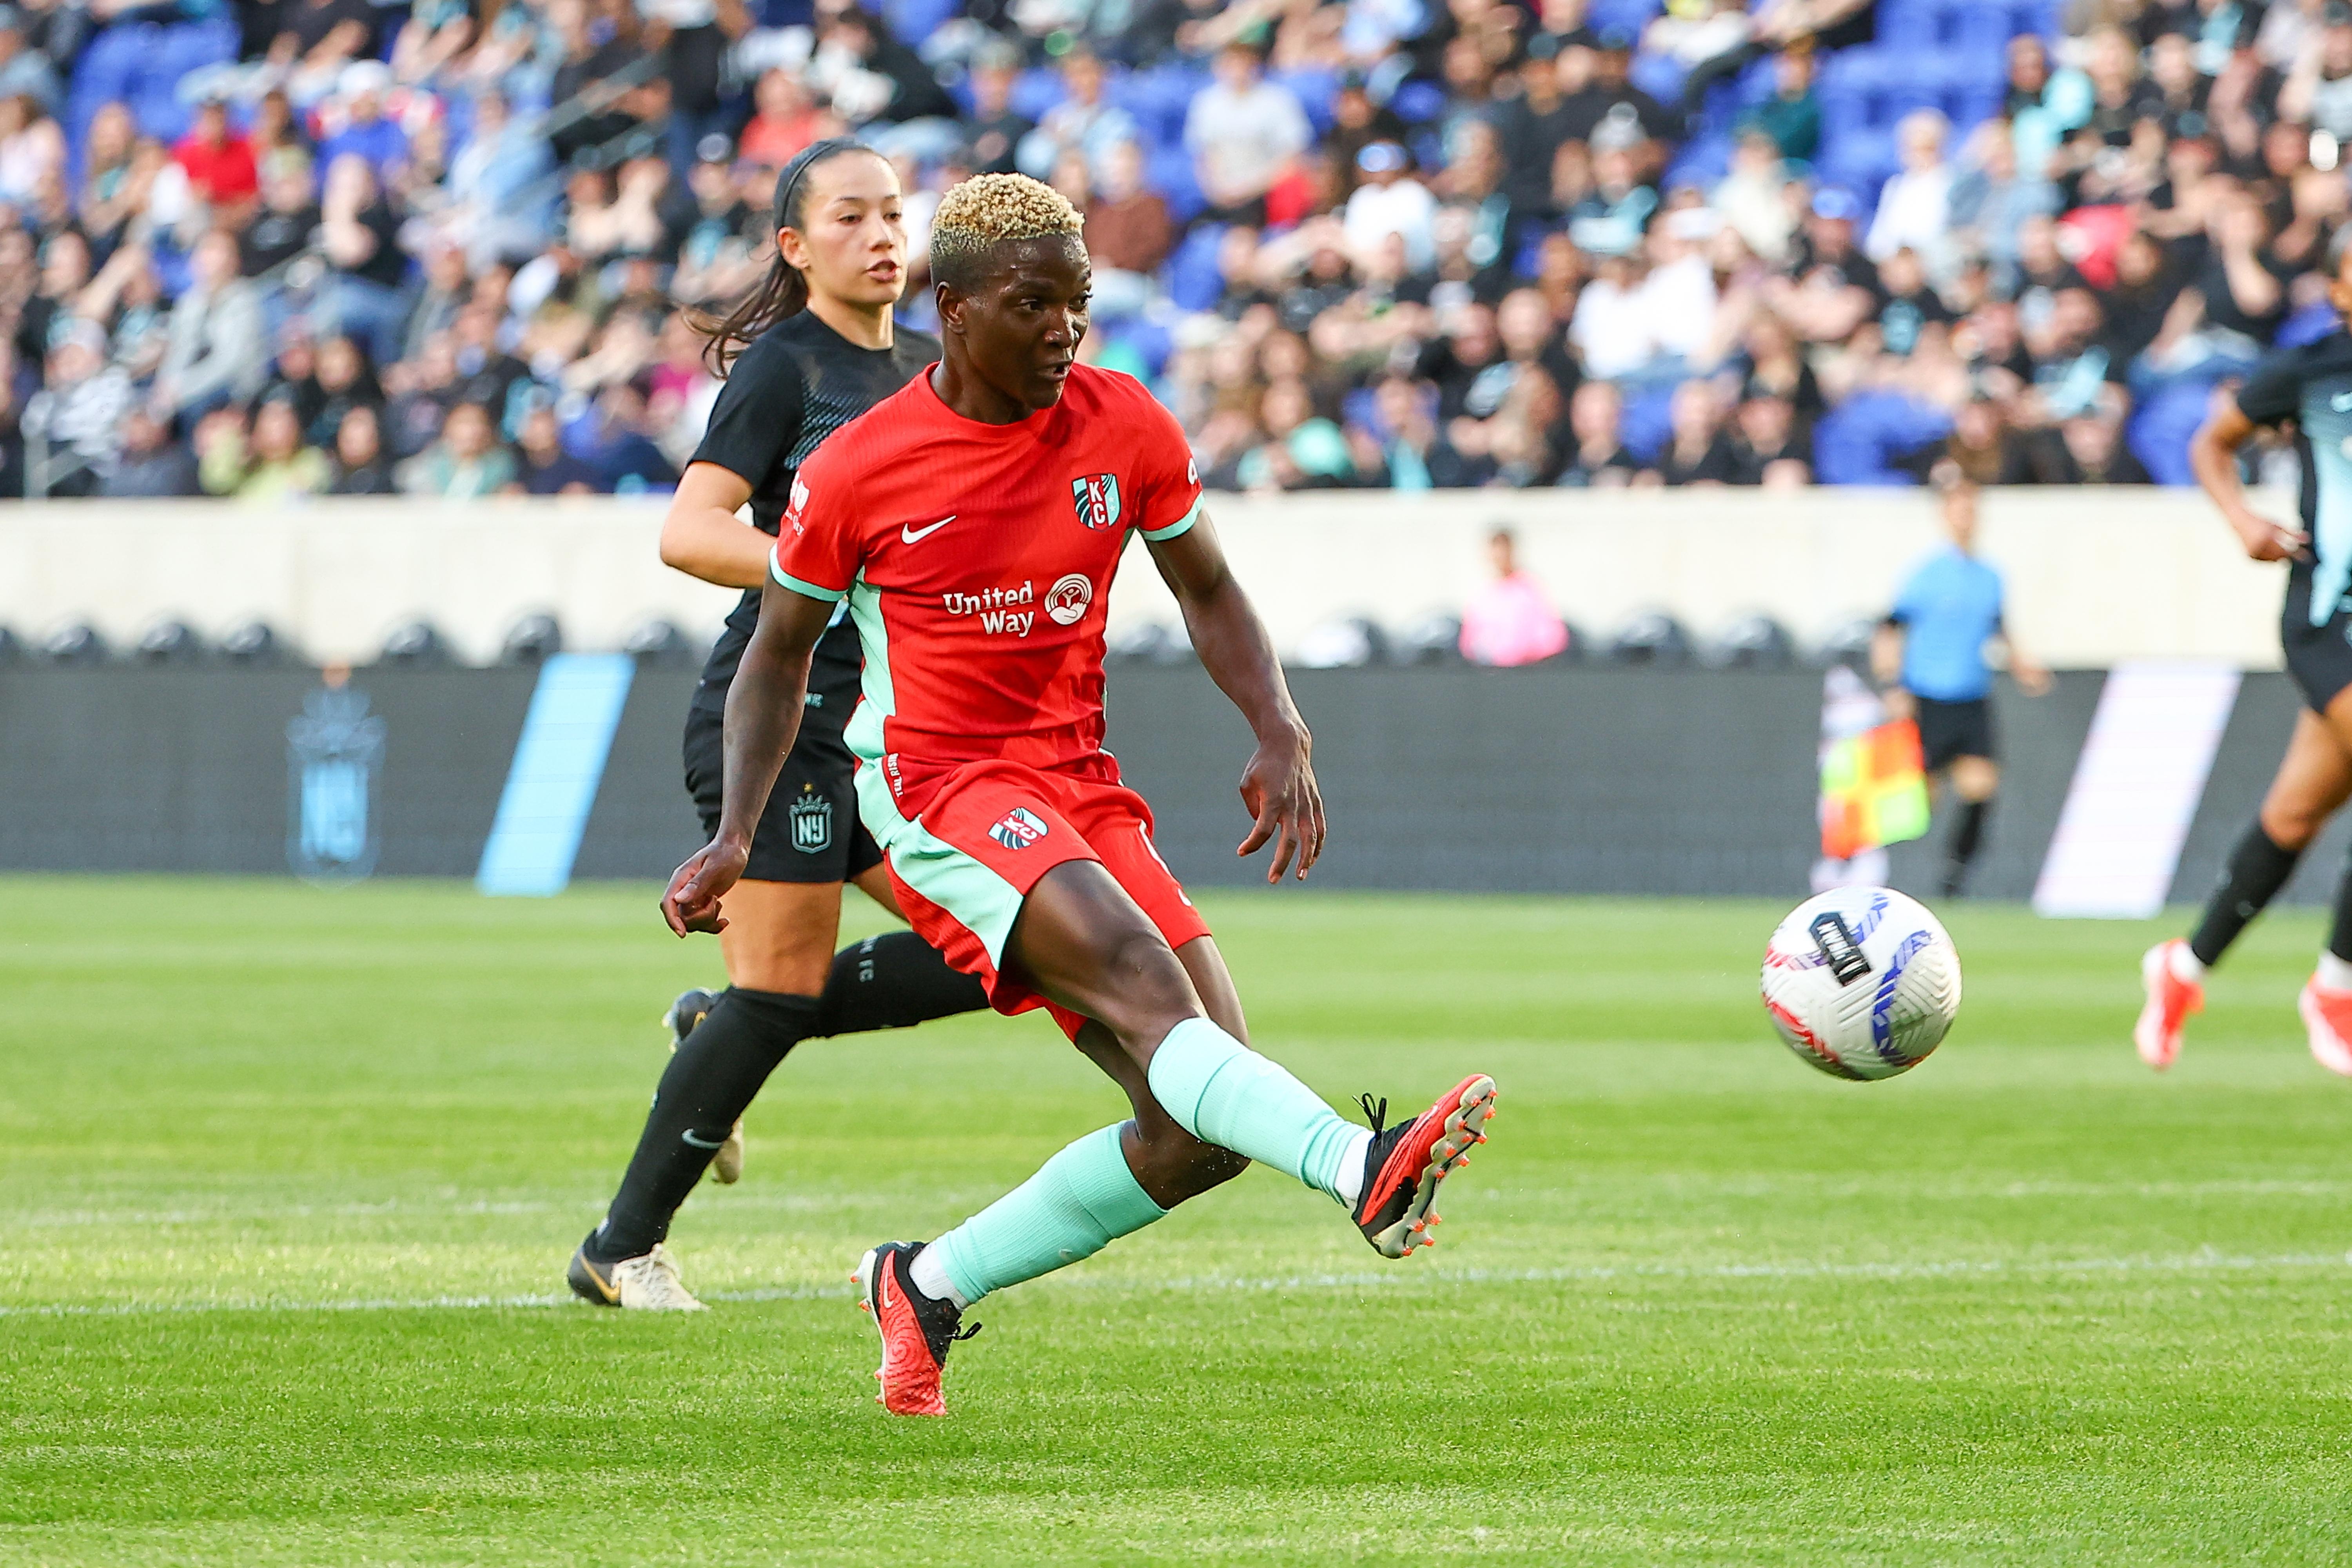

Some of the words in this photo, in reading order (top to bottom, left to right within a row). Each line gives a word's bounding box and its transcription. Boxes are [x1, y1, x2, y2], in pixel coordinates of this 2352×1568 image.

[943, 581, 1033, 614] United
[980, 610, 1034, 637] Way
[894, 776, 904, 798] TEAL
[797, 814, 825, 844] NY
[1003, 817, 1037, 840] KC
